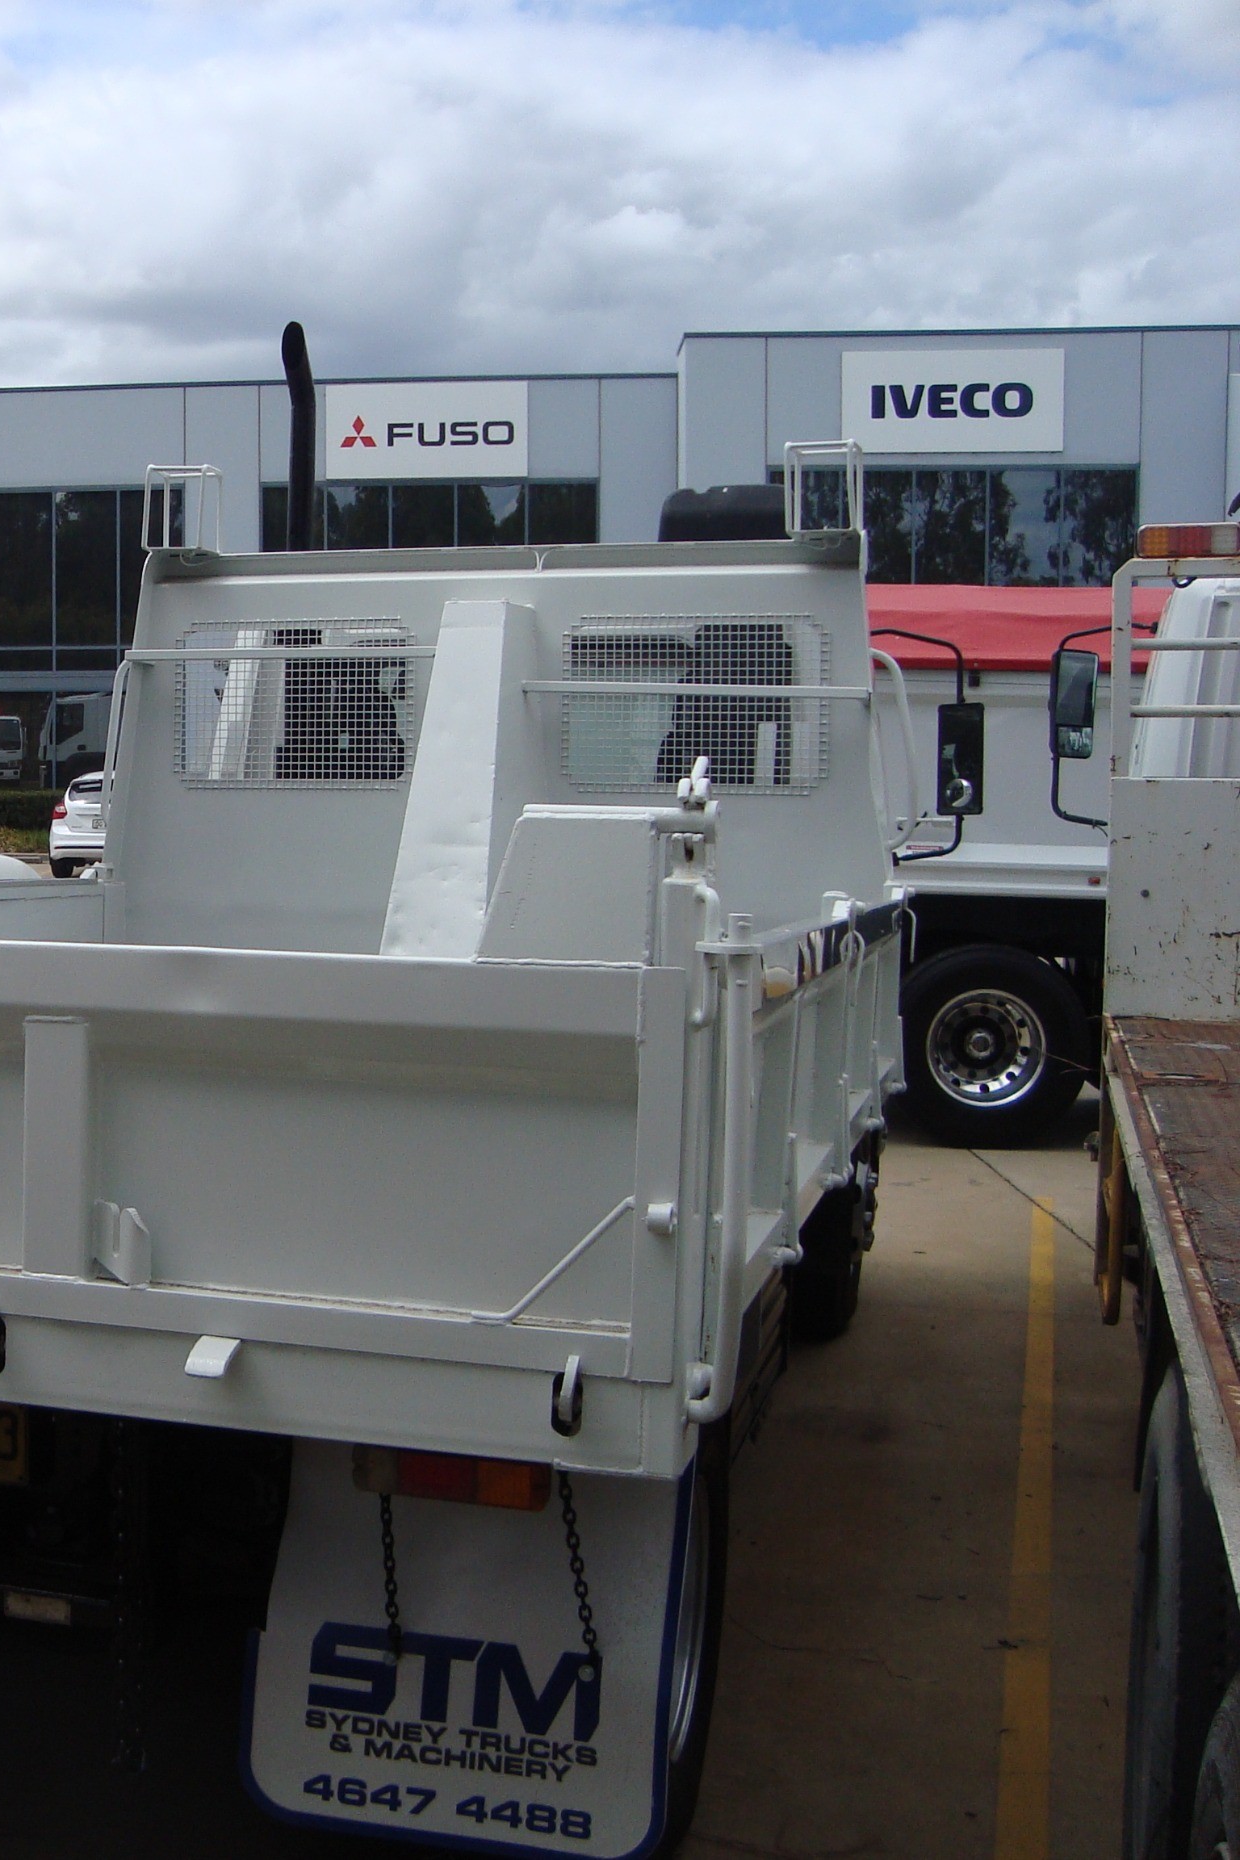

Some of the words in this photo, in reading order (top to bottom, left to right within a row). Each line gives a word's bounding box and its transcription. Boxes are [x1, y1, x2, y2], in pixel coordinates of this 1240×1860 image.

[871, 382, 1034, 420] IVECO
[387, 420, 515, 447] FUSO
[307, 1620, 603, 1743] STM
[304, 1708, 448, 1746] SYDNEY
[458, 1727, 599, 1767] TRUCKS
[329, 1733, 353, 1754] &
[363, 1740, 573, 1783] MACHINERY
[303, 1773, 438, 1816] 4647
[455, 1794, 593, 1840] 4488
